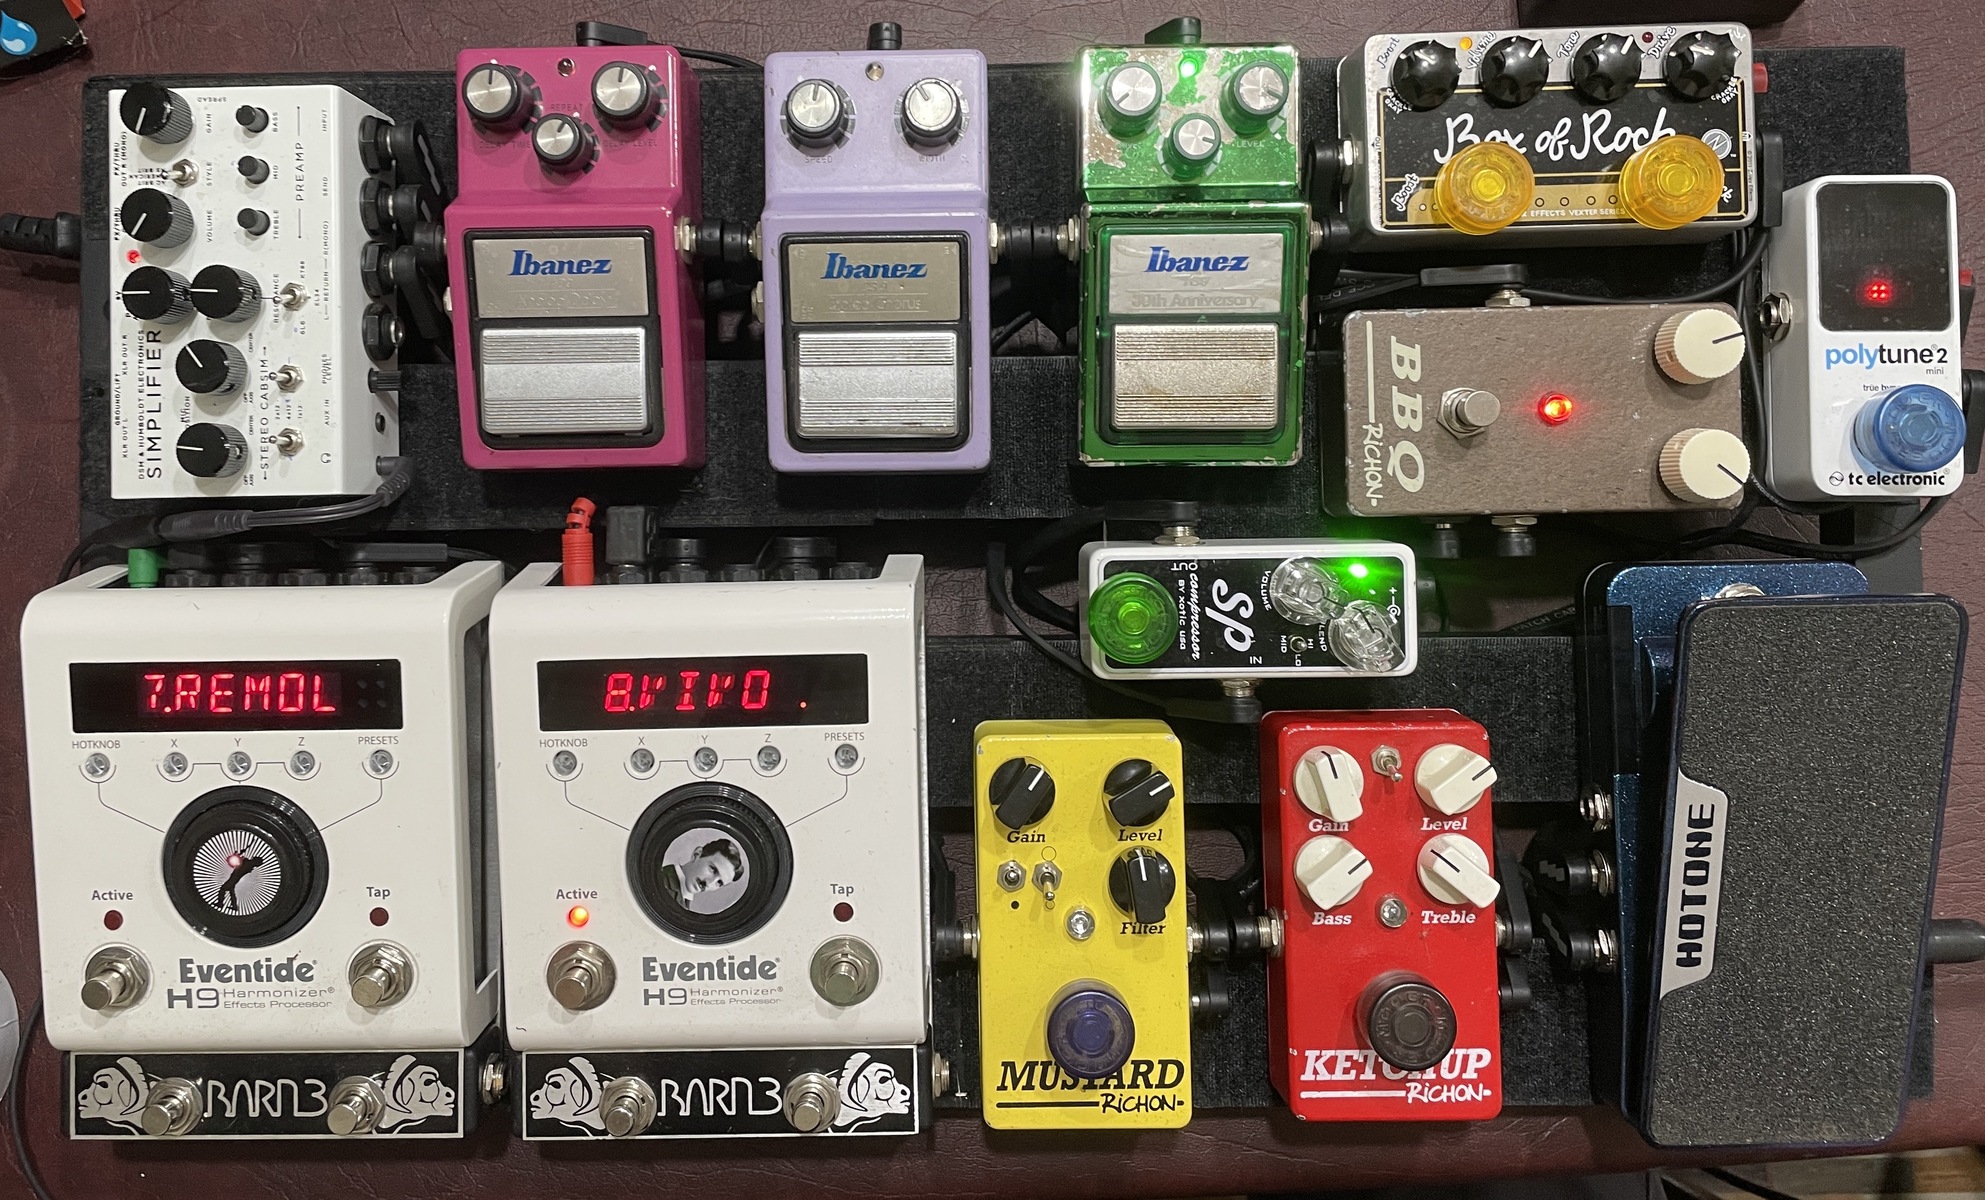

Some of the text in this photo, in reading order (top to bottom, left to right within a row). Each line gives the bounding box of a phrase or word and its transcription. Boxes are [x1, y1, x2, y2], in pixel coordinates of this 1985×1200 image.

[1556, 30, 1581, 59] Tone
[1648, 26, 1677, 59] Drive
[1376, 36, 1400, 69] Boost
[1466, 31, 1496, 70] Volume
[550, 103, 583, 112] REPEAT
[512, 141, 531, 149] TIME
[633, 139, 658, 147] LEVEL
[1236, 140, 1265, 148] LEVEL
[1534, 117, 1572, 161] of
[295, 142, 304, 201] PREAMP
[1391, 172, 1420, 212] Boost
[1530, 209, 1566, 217] EFFECTS
[1568, 208, 1598, 216] VEXTER
[508, 250, 613, 276] Ibanez
[820, 252, 928, 279] Ibanez
[1143, 246, 1250, 272] Ibanez
[1173, 293, 1259, 308] Anniversary
[1925, 366, 1945, 375] mini
[146, 330, 162, 479] SIMPLIFIER
[324, 399, 330, 408] IN
[260, 359, 269, 470] STEREO CABSIM
[1390, 335, 1425, 493] BBQ
[1848, 471, 1945, 485] tc electronic
[1170, 562, 1198, 571] OUT
[1178, 580, 1185, 593] BY
[1260, 570, 1272, 611] VOLUME
[1318, 619, 1328, 652] LEND
[1280, 635, 1288, 654] MID
[1307, 638, 1314, 649] HI
[1249, 656, 1263, 665] IN
[1295, 654, 1302, 667] LO
[71, 735, 399, 749] HOTKNOB X Y Z PRESETS
[539, 732, 865, 748] HOTKNOB X Y Z PRESETS
[1308, 818, 1350, 832] Gain
[1421, 817, 1468, 831] Level
[1006, 830, 1046, 843] Gain
[1117, 829, 1163, 842] Level
[830, 883, 855, 897] Tap
[1676, 803, 1715, 968] HOTONE
[91, 889, 134, 902] Active
[366, 886, 391, 901] Tap
[555, 887, 599, 900] Active
[1312, 911, 1352, 925] Bass
[1421, 910, 1476, 924] Treble
[1120, 922, 1167, 935] Filter
[167, 987, 220, 1009] H9
[643, 987, 688, 1006] H9
[690, 997, 782, 1006] Effects Processor
[223, 1000, 333, 1009] Effects Processor
